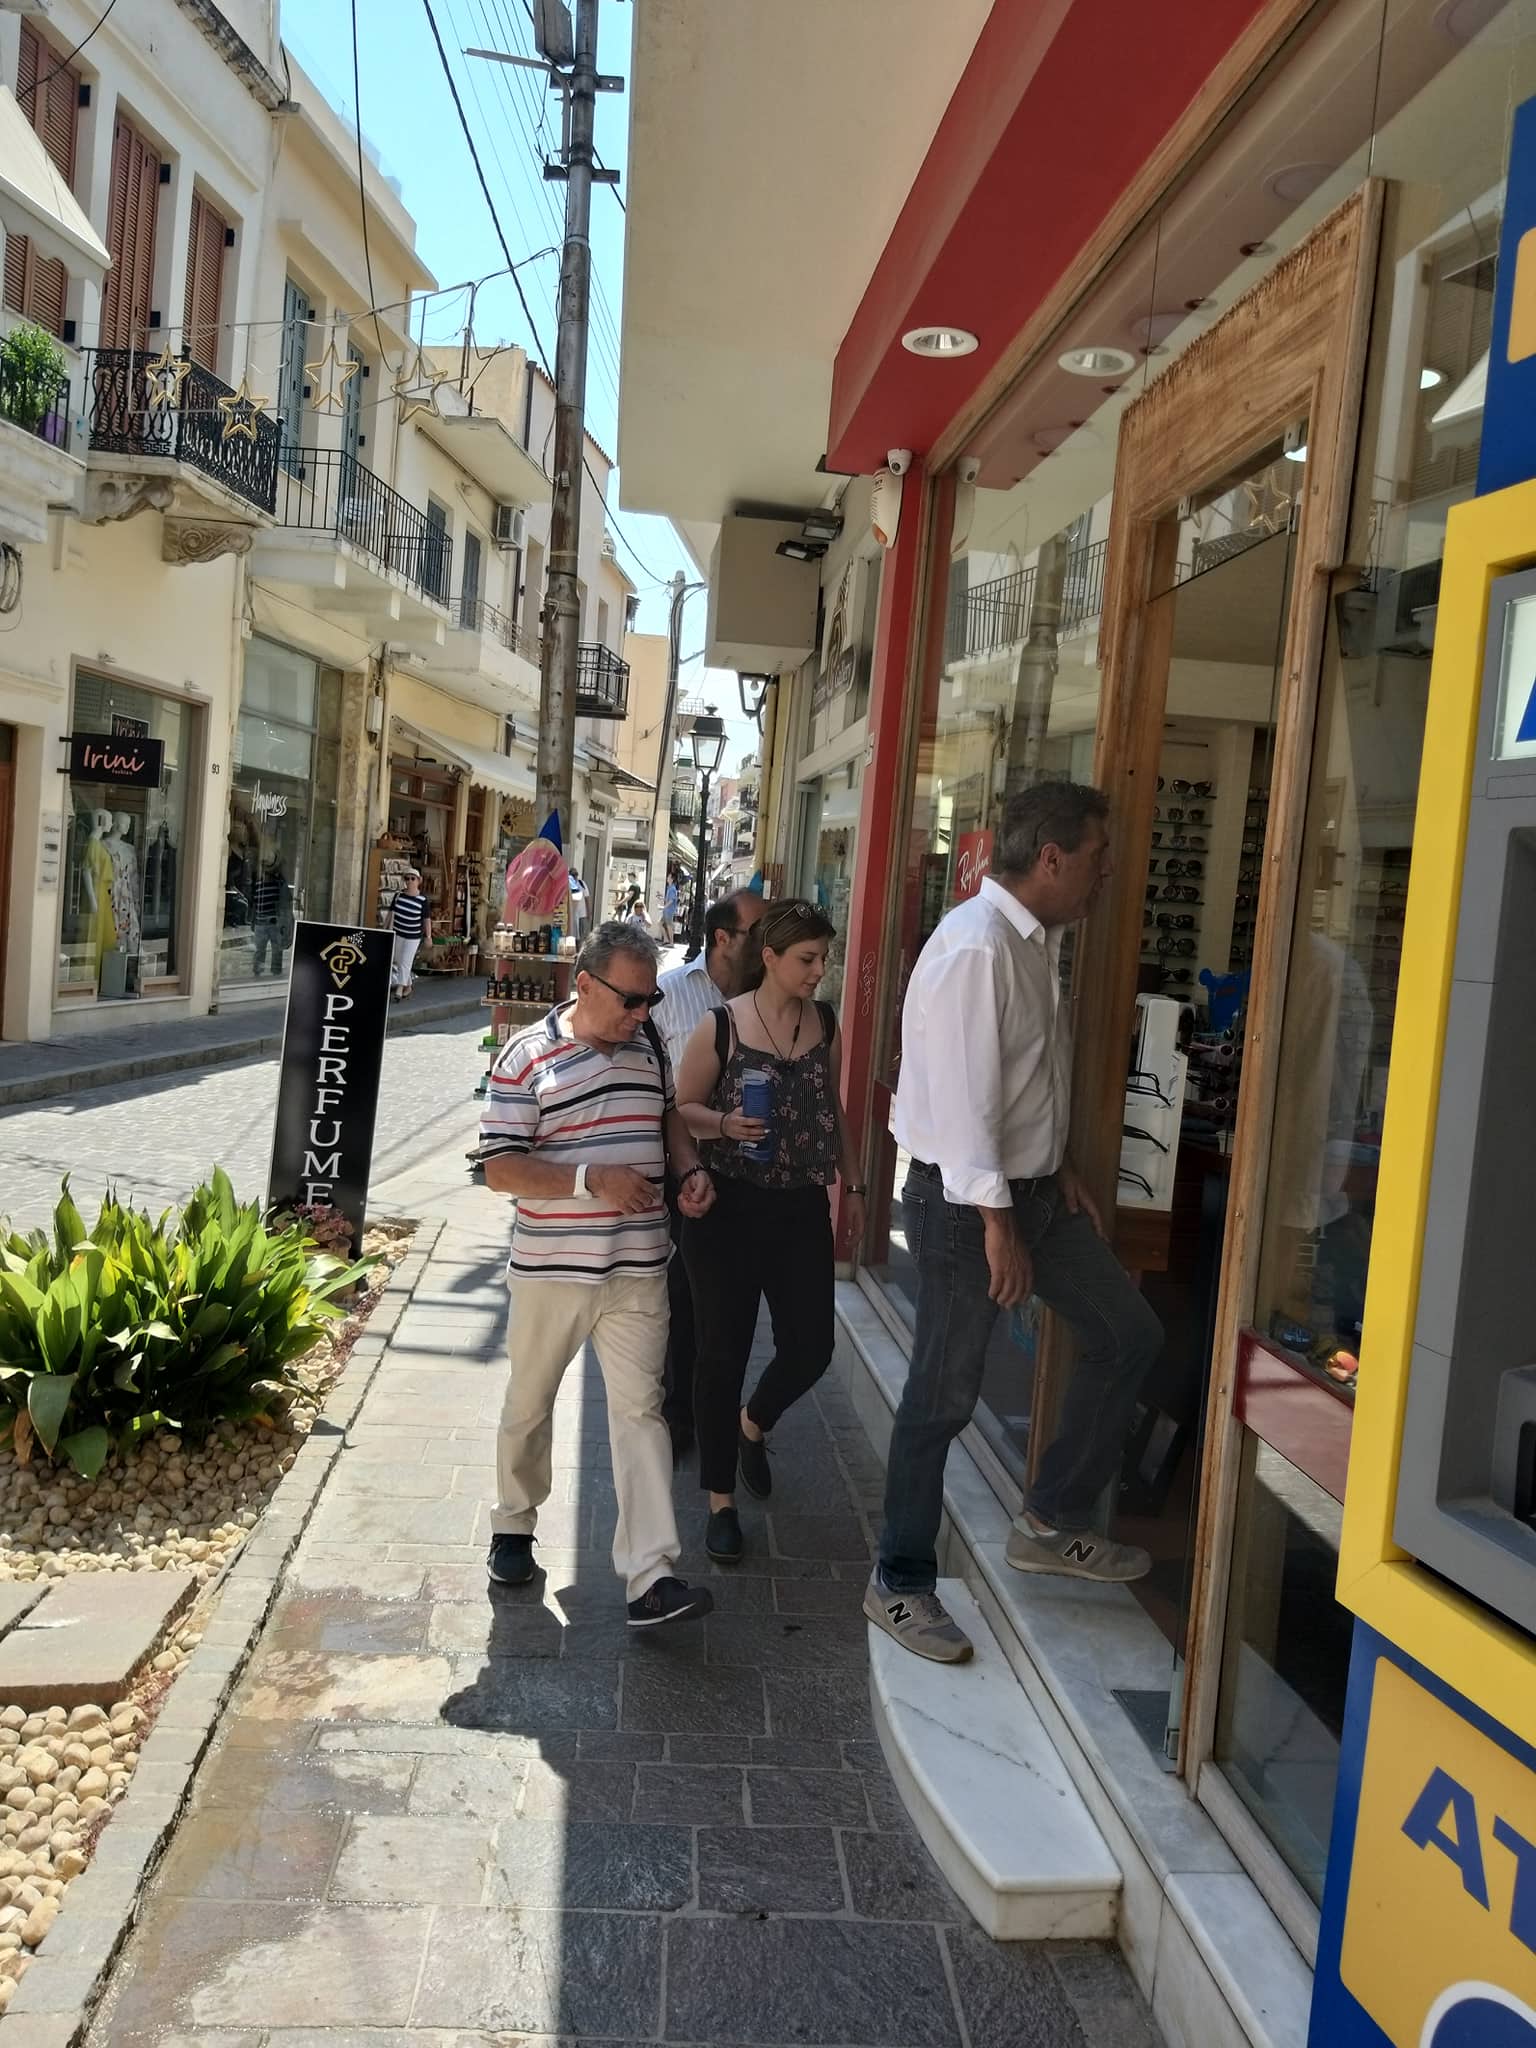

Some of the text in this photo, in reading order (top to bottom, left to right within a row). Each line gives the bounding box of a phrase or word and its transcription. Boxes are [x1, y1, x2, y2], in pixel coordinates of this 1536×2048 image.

[83, 745, 145, 772] Irini
[211, 763, 221, 775] 93
[251, 779, 288, 824] Happiness
[301, 994, 354, 1209] PERFUME
[1063, 1538, 1097, 1563] N
[886, 1601, 914, 1626] N
